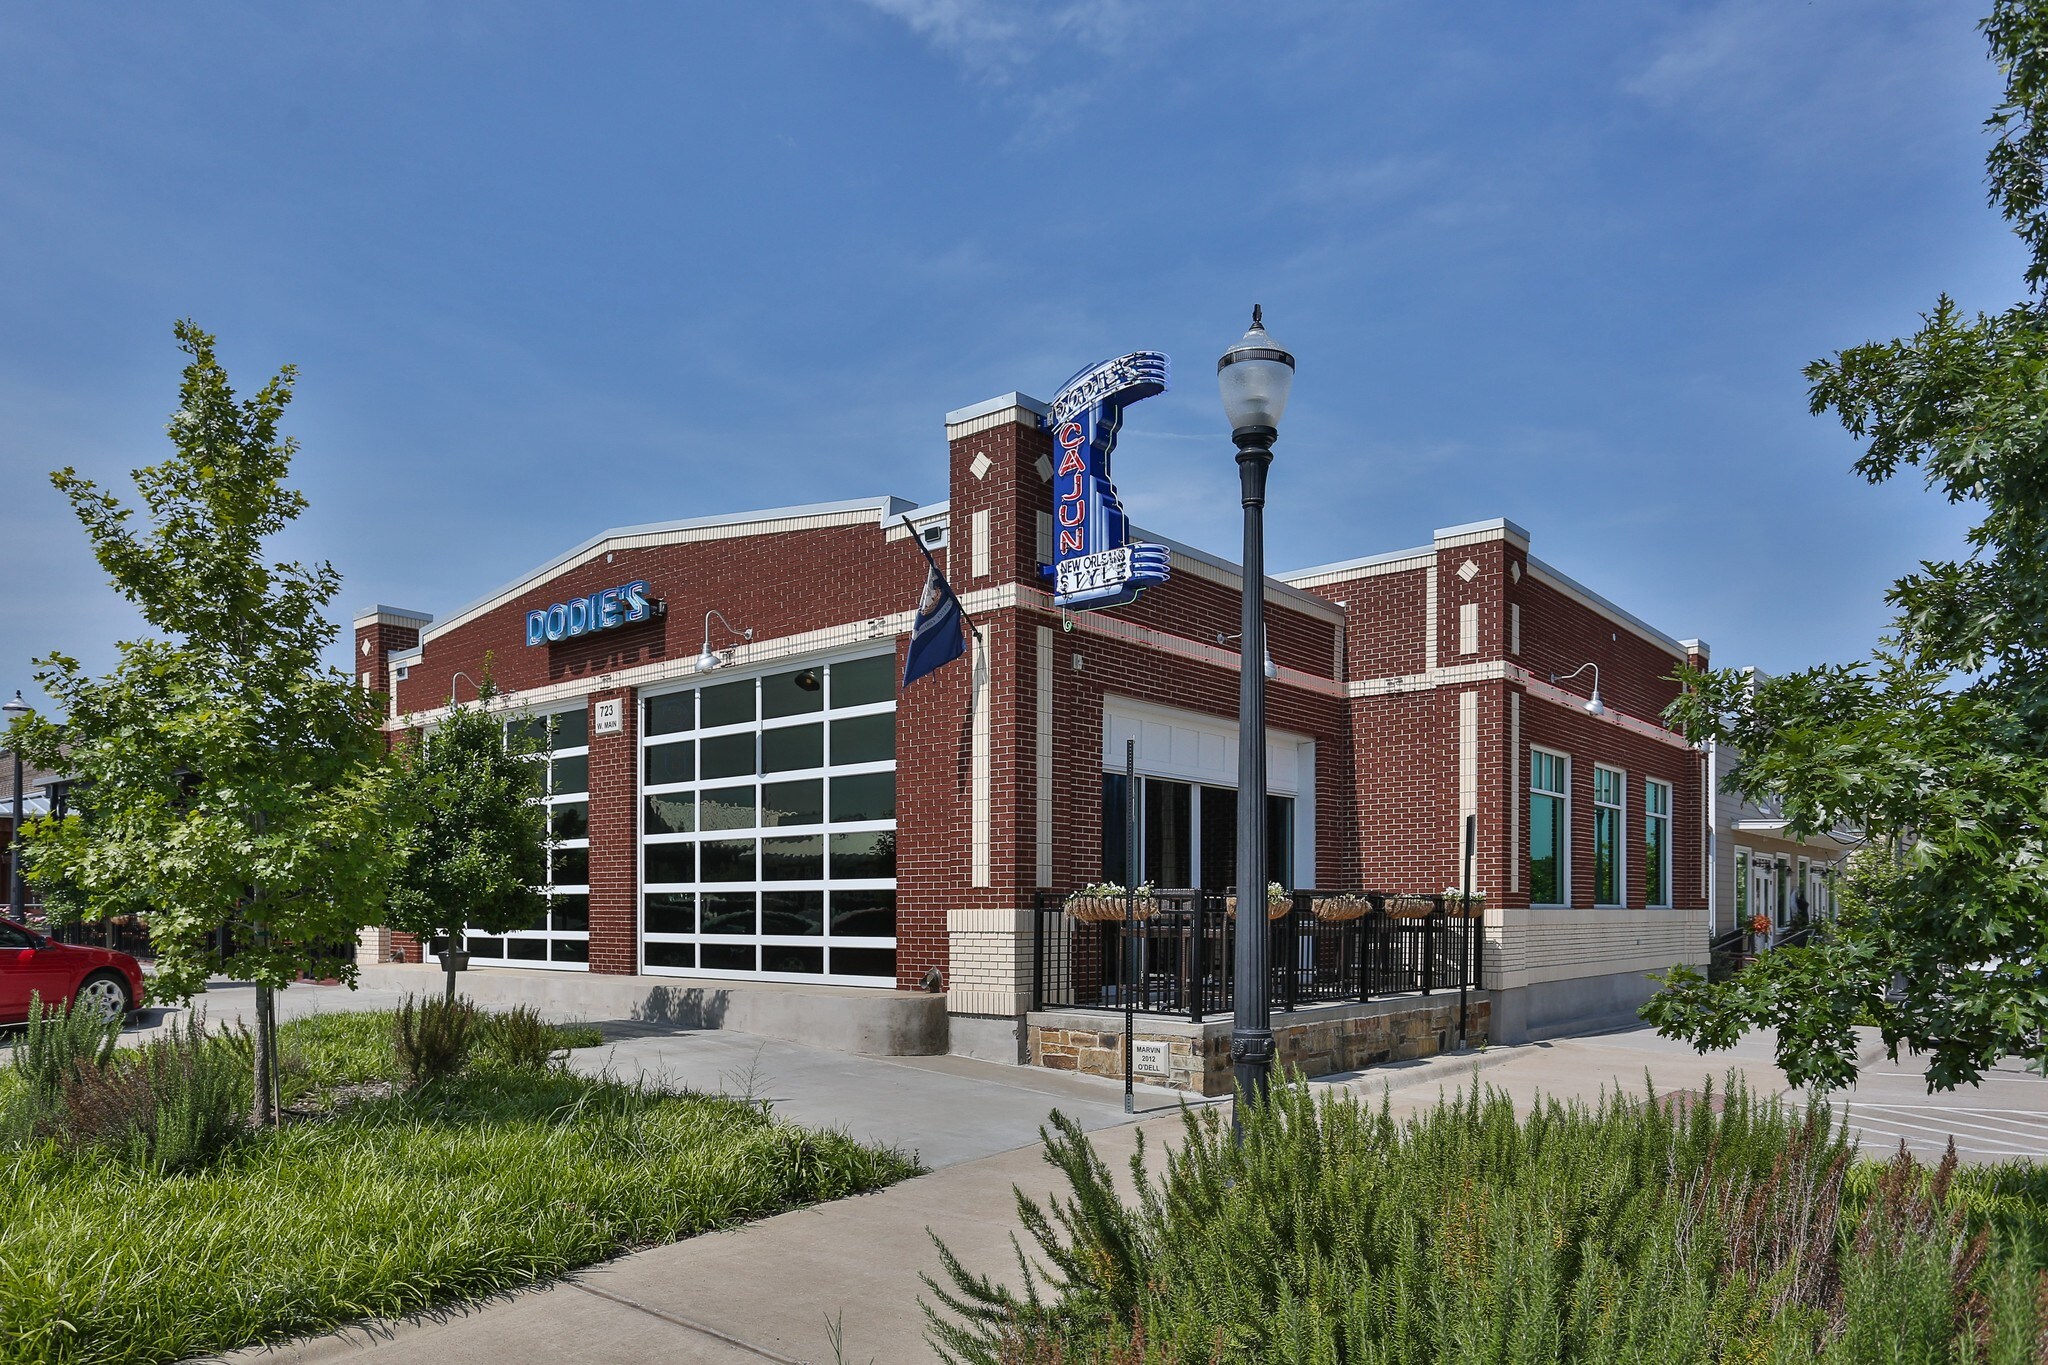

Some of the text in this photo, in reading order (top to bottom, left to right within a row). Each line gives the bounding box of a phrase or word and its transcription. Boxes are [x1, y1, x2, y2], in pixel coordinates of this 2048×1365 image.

[1058, 422, 1086, 555] CAJUN
[1060, 549, 1125, 574] NEW ORLEANS
[1060, 562, 1126, 592] STYLE
[526, 579, 651, 647] DODIE'S
[600, 704, 614, 717] 723
[597, 720, 617, 730] W. MAIN
